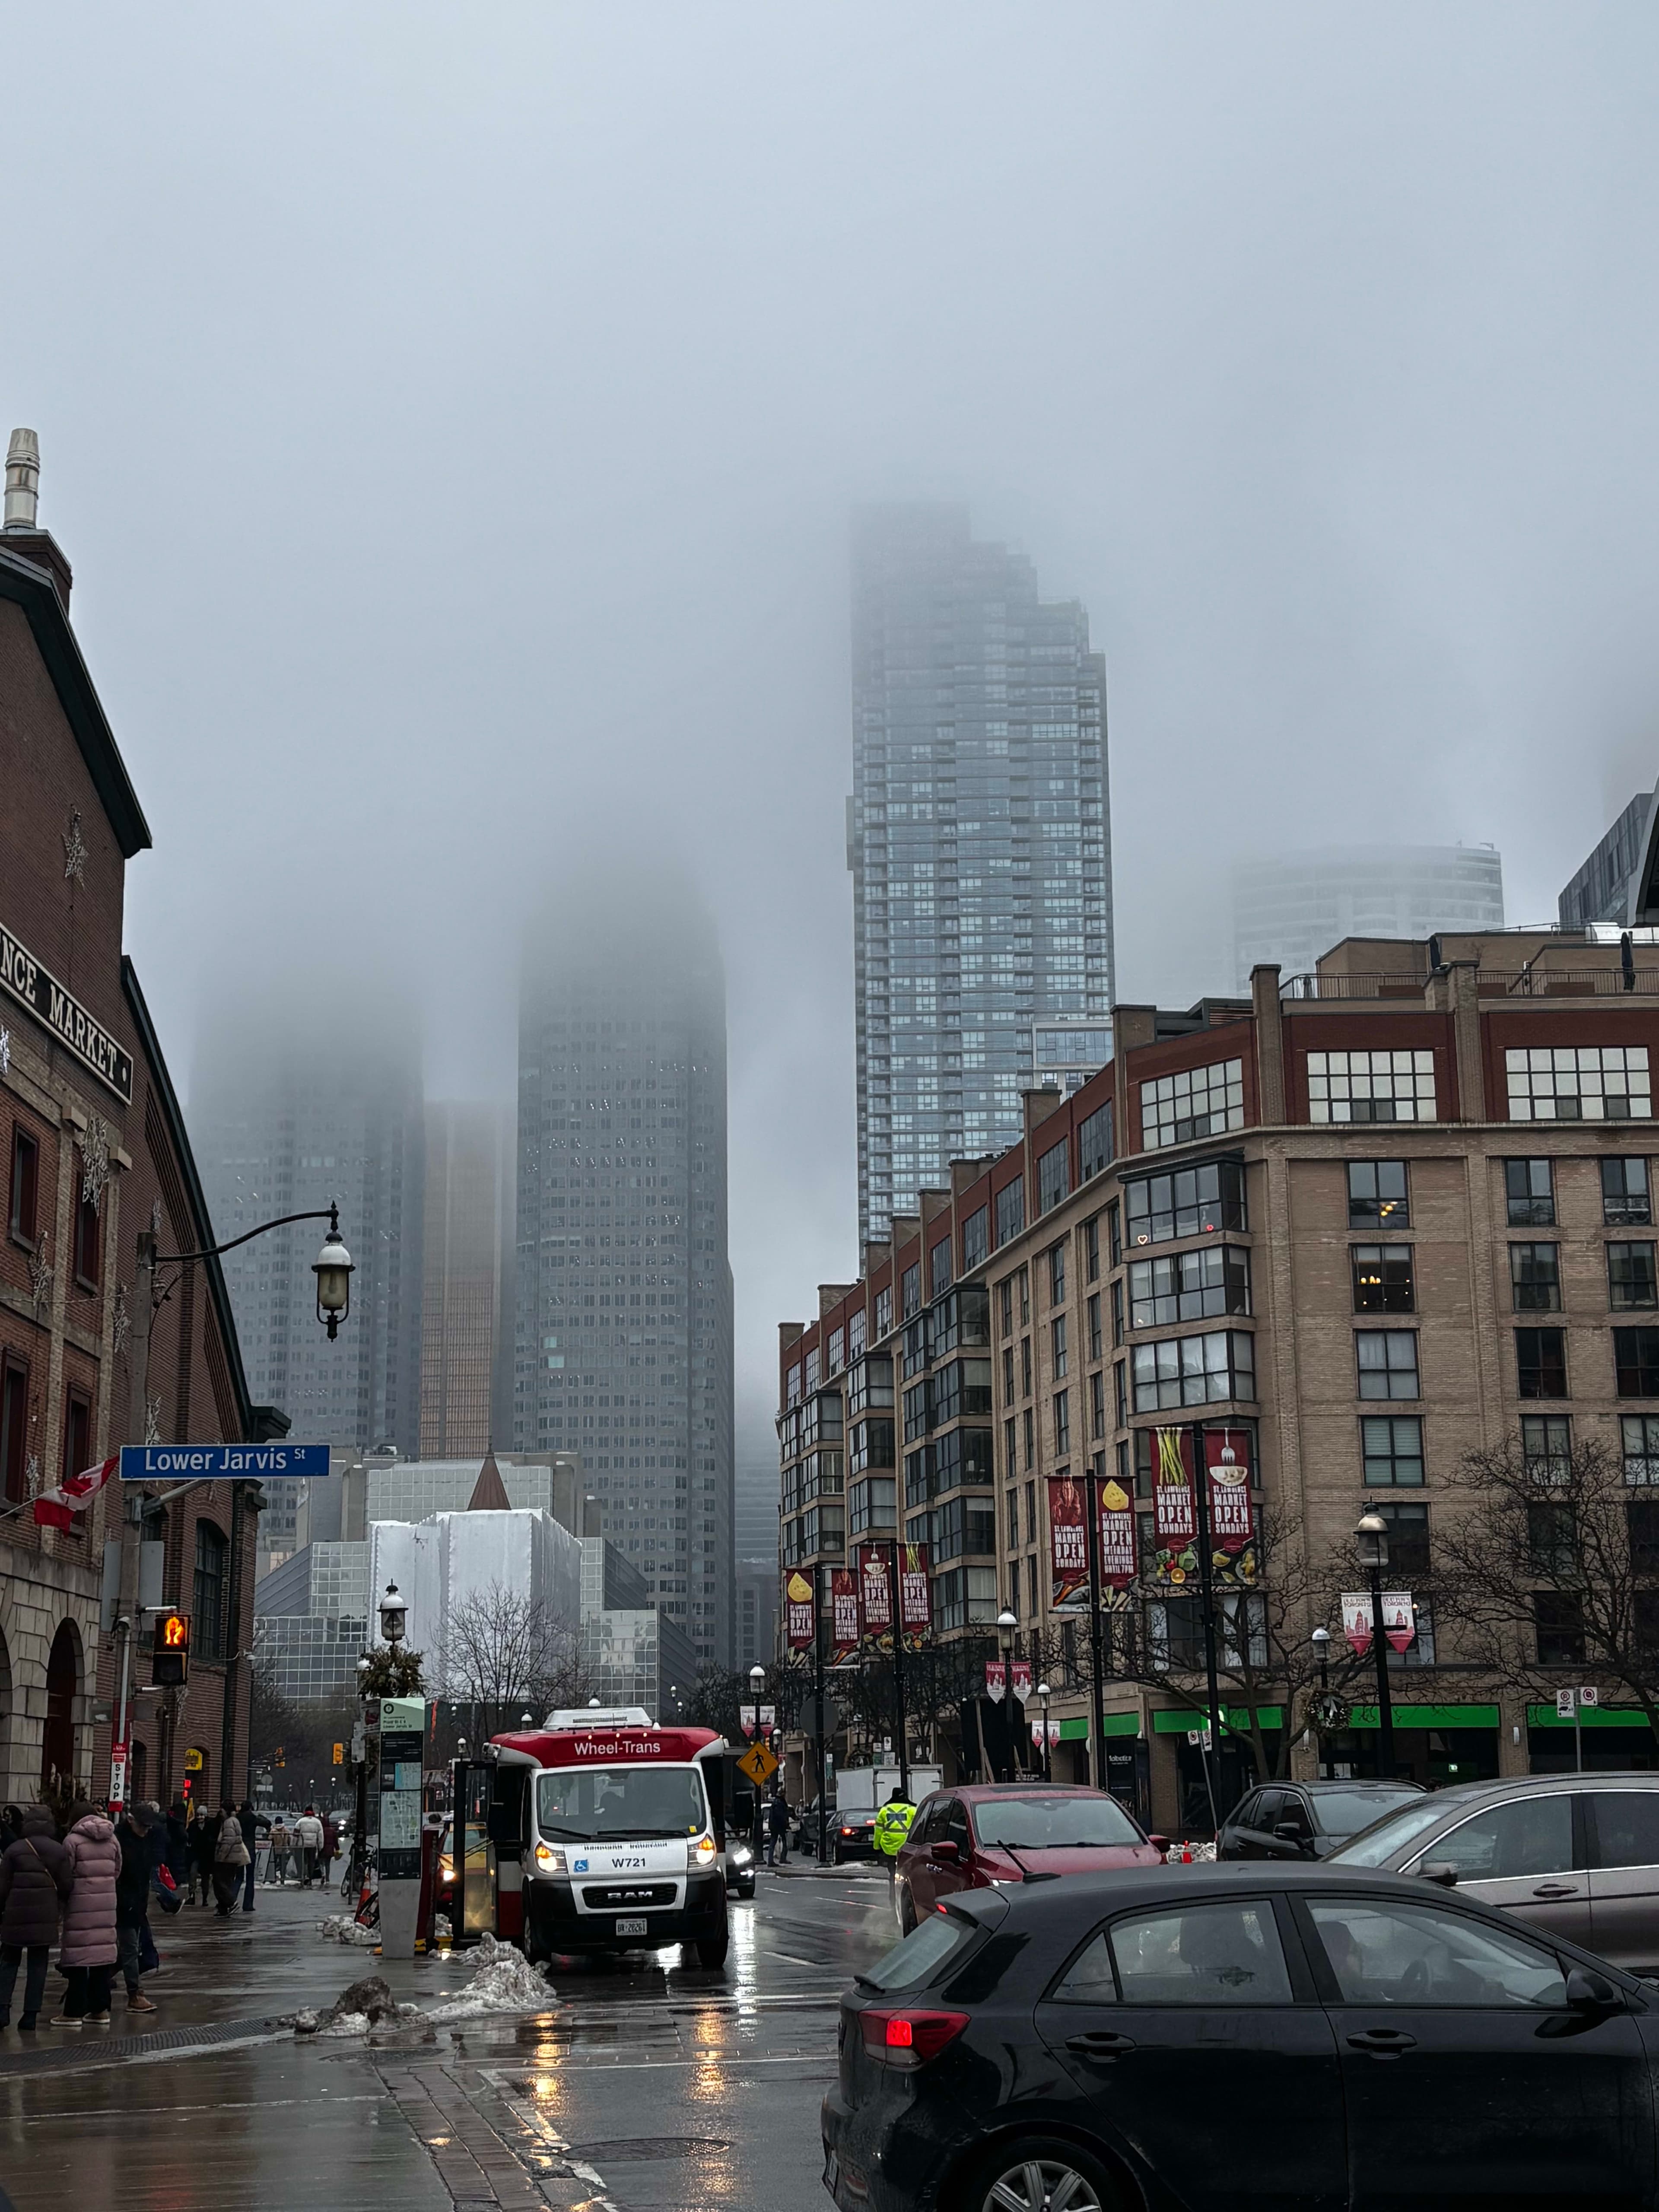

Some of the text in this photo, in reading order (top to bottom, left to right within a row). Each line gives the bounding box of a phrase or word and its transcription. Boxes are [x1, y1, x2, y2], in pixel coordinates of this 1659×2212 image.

[0, 931, 117, 1080] NCE MARKET
[145, 1447, 305, 1470] Lower Jarvis St
[1157, 1493, 1191, 1506] MARKET
[1214, 1494, 1247, 1506] MARKET
[1158, 1506, 1192, 1522] OPEN
[1214, 1506, 1248, 1522] OPEN
[1102, 1520, 1131, 1531] MARKET
[1159, 1523, 1193, 1534] SUNDAYS
[1215, 1523, 1249, 1534] SUNDAYS
[1055, 1532, 1084, 1544] MARKET
[1103, 1531, 1132, 1545] OPEN
[1055, 1544, 1085, 1558] OPEN
[1055, 1558, 1086, 1568] SUNDAYS
[865, 1588, 888, 1600] OPEN
[904, 1587, 927, 1599] OPEN
[574, 1741, 661, 1756] Wheel-Trans
[612, 1858, 646, 1868] W721
[607, 1891, 653, 1900] RAM
